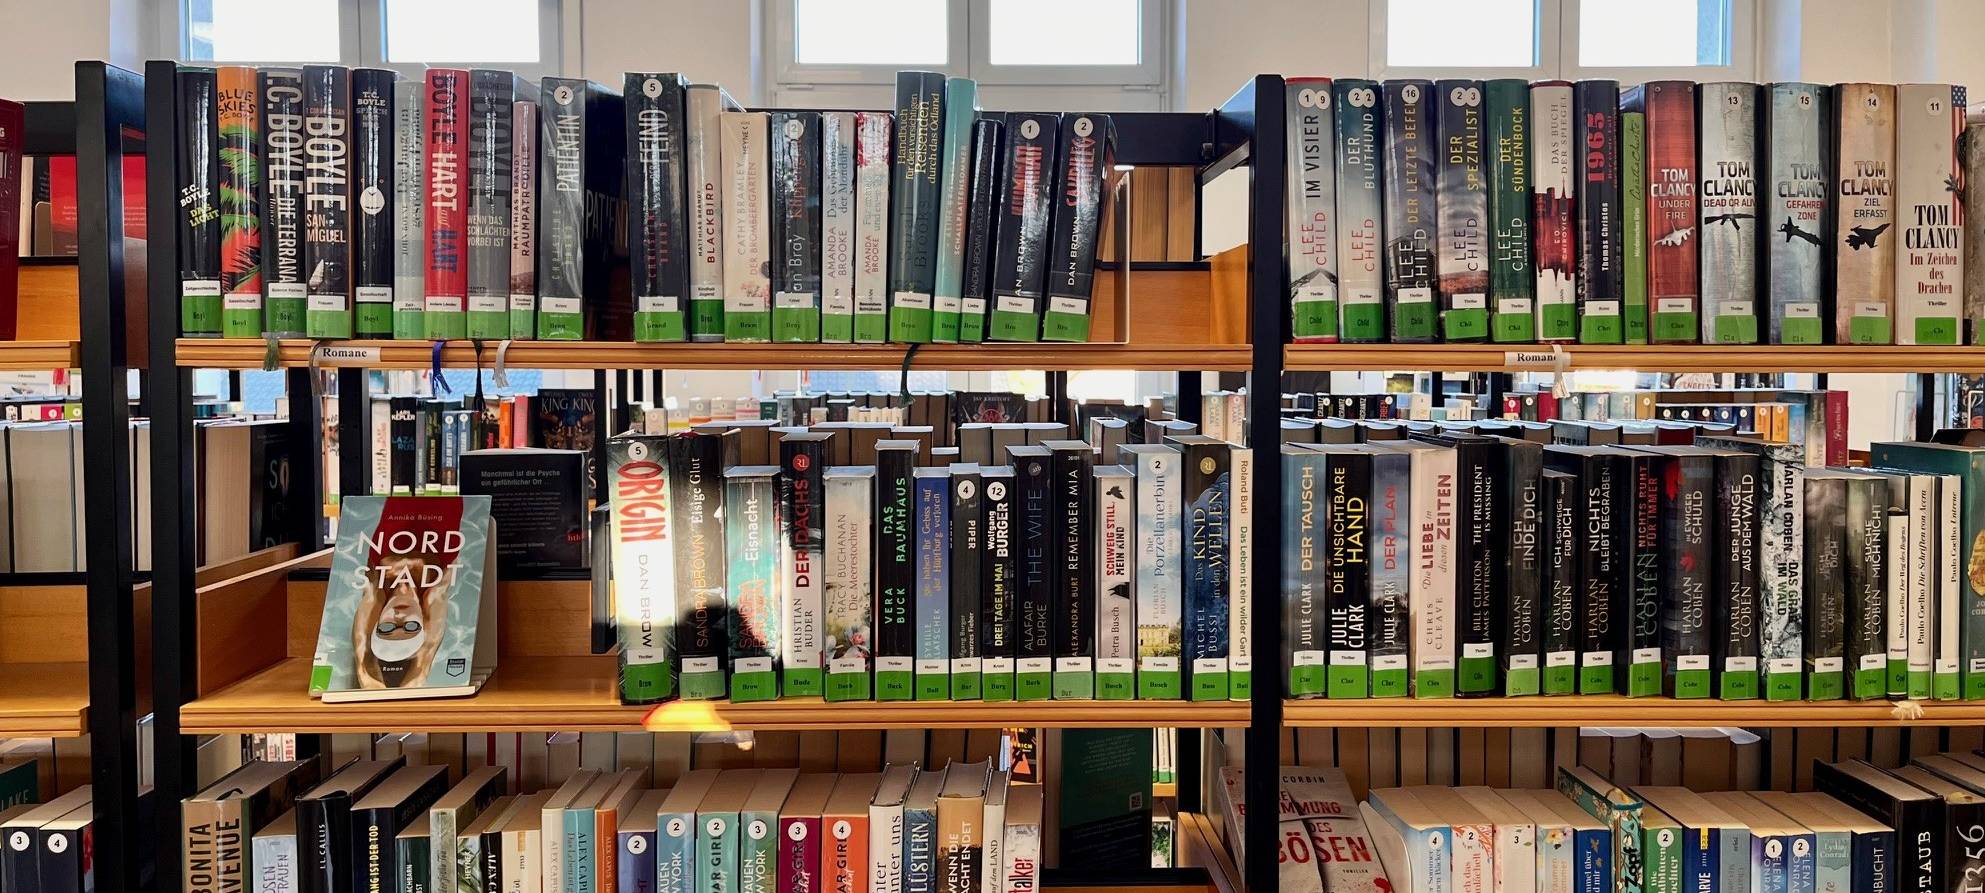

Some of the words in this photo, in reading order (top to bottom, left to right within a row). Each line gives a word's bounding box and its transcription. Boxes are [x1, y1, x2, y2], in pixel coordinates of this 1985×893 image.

[218, 88, 254, 102] BLUE
[267, 72, 303, 109] T.C.
[561, 90, 568, 99] 2
[649, 82, 656, 92] 5
[1354, 92, 1361, 101] 2
[1365, 93, 1372, 102] 2
[1406, 89, 1416, 99] 16
[1456, 91, 1463, 100] 2
[1470, 92, 1476, 101] 3
[218, 101, 256, 115] SKIES
[357, 98, 386, 106] BOYLE
[431, 74, 457, 145] BOYLE
[1727, 96, 1739, 105] 13
[1800, 96, 1810, 105] 15
[1867, 98, 1878, 107] 14
[1929, 102, 1940, 111] 11
[638, 108, 669, 164] FEIND
[898, 108, 907, 165] Handbuch
[914, 101, 930, 174] Reisenden
[1080, 122, 1088, 132] 2
[267, 114, 303, 194] BOYLE
[556, 114, 581, 193] PATIENTIN
[1304, 114, 1320, 172] VISIER
[1348, 136, 1361, 165] DER
[1362, 112, 1375, 189] BLUTHUND
[1450, 135, 1463, 165] DER
[1465, 108, 1479, 191] SPEZIALIST
[1499, 137, 1511, 163] DER
[1512, 106, 1524, 193] SÜNDENBOCK
[1586, 111, 1606, 184] 1965
[305, 117, 346, 211] BOYLE
[1405, 145, 1417, 193] LETZTE
[1661, 168, 1689, 183] TOM
[1716, 161, 1751, 178] TOM
[1790, 163, 1821, 181] TOM
[1854, 160, 1887, 178] TOM
[182, 184, 200, 196] T.C.
[431, 152, 458, 211] HART
[1305, 180, 1321, 198] IM
[1650, 182, 1696, 197] CLANCY
[1703, 179, 1757, 197] CLANCY
[1778, 182, 1829, 199] CLANCY
[1841, 179, 1894, 196] CLANCY
[179, 187, 211, 207] BOYLE
[1658, 199, 1691, 209] UNDER
[1703, 199, 1727, 208] DEAD
[1786, 199, 1826, 209] GEFAHREN
[1864, 198, 1881, 207] ZIEL
[189, 210, 220, 228] LIGHT
[306, 214, 327, 228] SAN
[467, 215, 488, 226] WENN
[489, 215, 504, 225] DAS
[705, 182, 715, 264] BLACKBIRD
[1601, 202, 1609, 237] Christos
[1665, 211, 1687, 220] FIRE
[1797, 211, 1817, 221] ZONE
[1854, 209, 1888, 219] ERFASST
[1914, 204, 1949, 226] TOM
[306, 229, 347, 243] MIGUEL
[467, 226, 511, 237] SCHLACHTEN
[467, 237, 493, 247] VORBEI
[1070, 216, 1080, 258] BROWN
[1302, 222, 1315, 255] LEE
[1315, 212, 1327, 266] CHILD
[1905, 228, 1959, 249] CLANCY
[826, 226, 837, 279] AMANDA
[838, 229, 848, 277] BROOKE
[1352, 229, 1364, 261] LEE
[1364, 218, 1375, 272] CHILD
[1453, 228, 1467, 261] LEE
[1467, 218, 1478, 272] CHILD
[1497, 228, 1511, 261] LEE
[1511, 217, 1524, 272] CHILD
[1601, 240, 1609, 272] Thomas
[1399, 241, 1414, 279] LEE
[1414, 228, 1428, 290] CHILD
[1910, 252, 1923, 266] Im
[1927, 252, 1958, 266] Zeichen
[1067, 261, 1078, 287] DAN
[1929, 267, 1945, 280] des
[1917, 282, 1953, 295] Drachen
[322, 348, 368, 358] Romane
[391, 413, 416, 421] KEPLER
[635, 446, 642, 455] 5
[1155, 460, 1162, 470] 2
[1241, 460, 1249, 493] Roland
[962, 485, 970, 495] 4
[991, 486, 1003, 497] 12
[1068, 469, 1079, 496] MIA
[1473, 465, 1483, 522] PRESIDENT
[617, 460, 667, 543] ORIGIN
[689, 487, 705, 524] Eisige
[1240, 494, 1249, 515] Buti
[1301, 465, 1313, 532] TAUSCH
[1437, 474, 1451, 540] ZEITEN
[1742, 475, 1754, 520] WALD
[417, 513, 443, 521] Büsing
[743, 481, 760, 562] Eisnacht
[795, 479, 810, 544] DACHS
[884, 505, 894, 535] DAS
[895, 477, 907, 562] BAUMHAUS
[1334, 466, 1345, 567] UNSICHTBARE
[1589, 487, 1601, 552] NICHTS
[1692, 490, 1703, 544] SCHULD
[987, 510, 996, 550] Wolfgang
[996, 502, 1009, 558] BURGER
[1068, 501, 1079, 570] REMEMBER
[1193, 508, 1206, 561] KIND
[1208, 491, 1225, 569] WELLEN
[1347, 497, 1364, 563] HAND
[357, 530, 467, 556] NORD
[1106, 532, 1116, 577] SCHWEIG
[1422, 523, 1434, 569] LIEBE
[351, 564, 464, 590] STADT
[796, 549, 809, 588] DER
[994, 562, 1004, 581] MAI
[994, 583, 1004, 596] IM
[884, 587, 894, 625] VERA
[896, 587, 906, 625] BUCK
[994, 597, 1004, 622] TAGE
[1740, 587, 1752, 638] COBEN
[994, 623, 1004, 647] DREI
[1332, 608, 1347, 646] JULIE
[1349, 604, 1365, 648] CLARK
[382, 665, 404, 673] Roman
[368, 824, 379, 840] TOD
[673, 822, 681, 832] 2
[713, 822, 720, 831] 2
[755, 825, 762, 835] 3
[794, 827, 801, 836] 3
[838, 825, 846, 835] 4
[891, 815, 902, 847] uns
[1309, 821, 1333, 833] DES
[1662, 833, 1669, 843] 2
[16, 836, 23, 845] 3
[54, 839, 61, 849] 4
[633, 840, 640, 849] 2
[961, 821, 972, 861] ENDET
[1431, 836, 1438, 846] 4
[1514, 835, 1520, 845] 3
[1797, 842, 1804, 851] 2
[189, 823, 213, 893] BONITA
[671, 850, 682, 881] YORK
[756, 849, 767, 879] YORK
